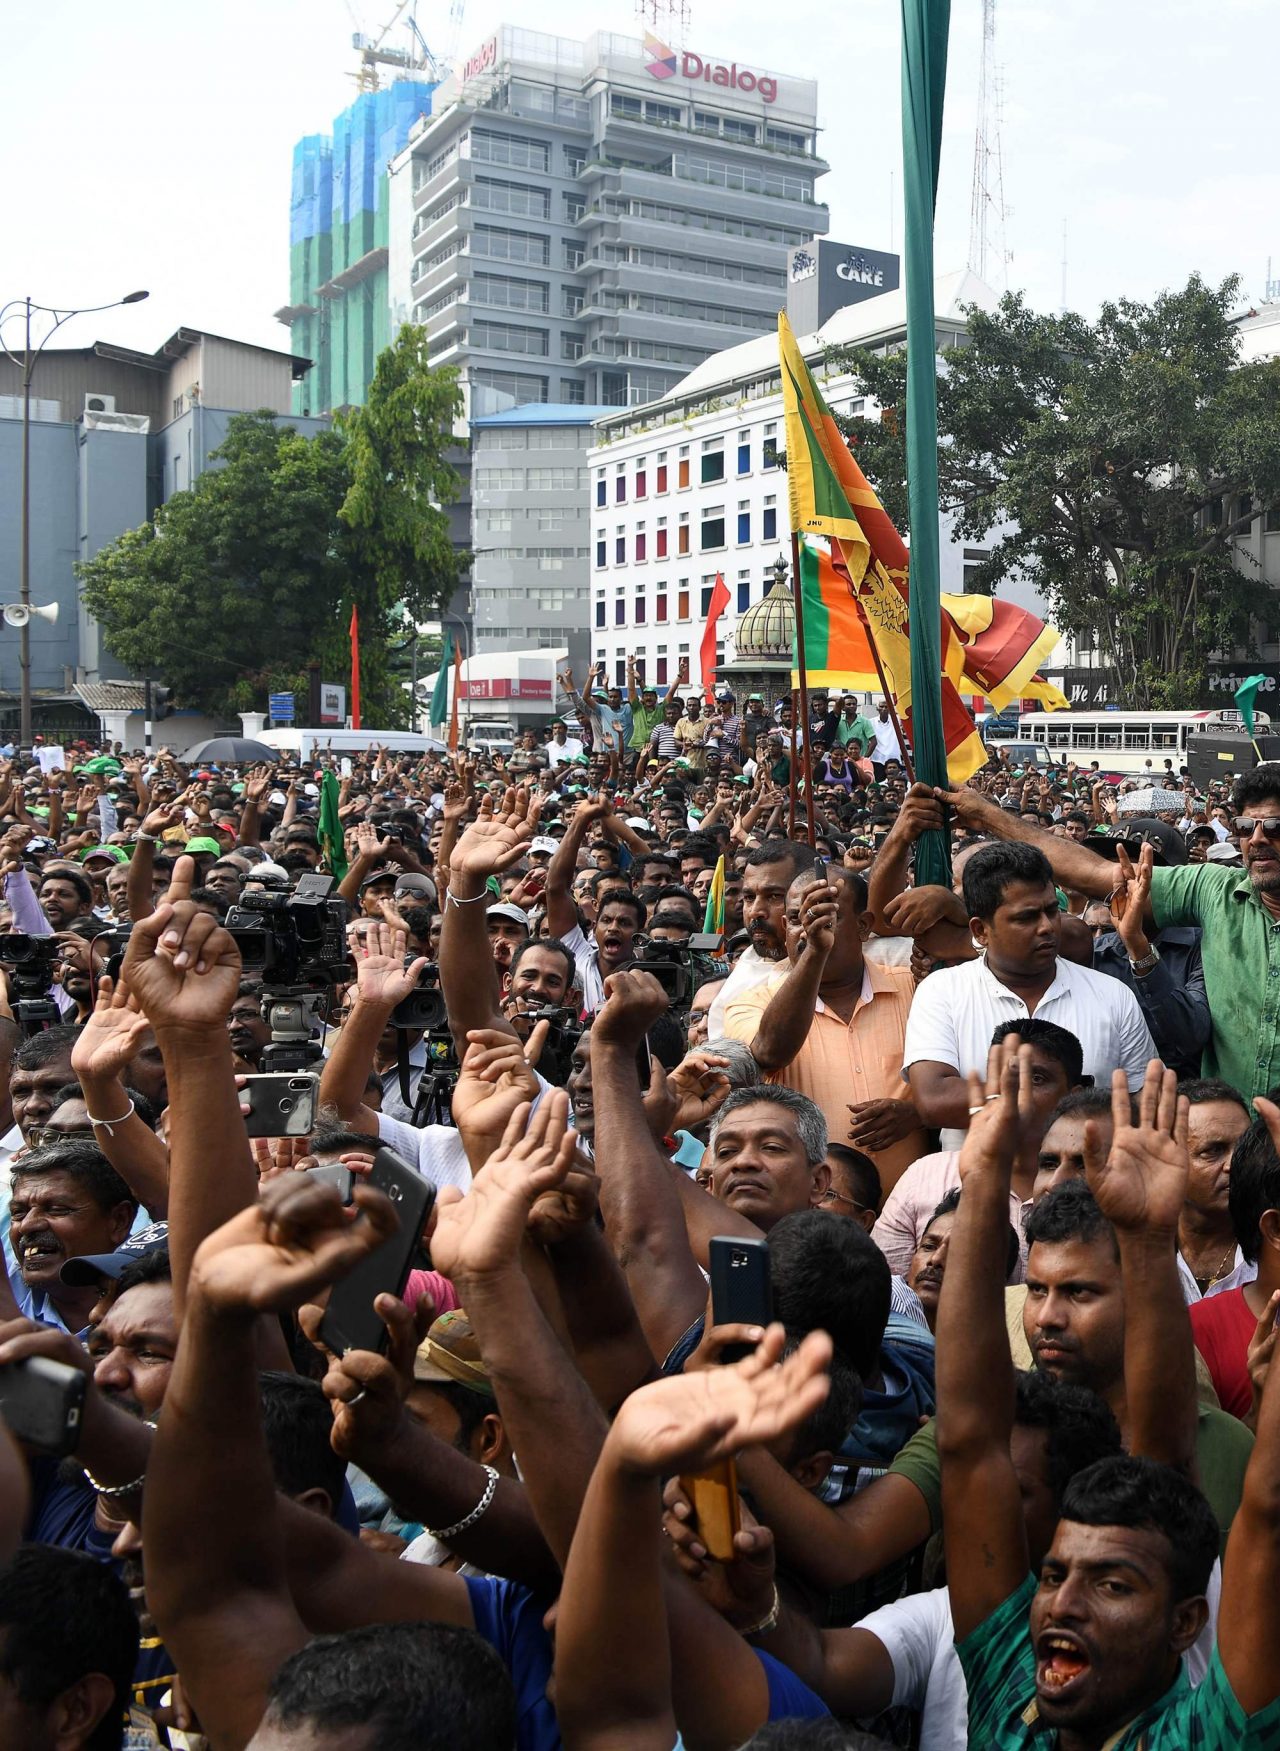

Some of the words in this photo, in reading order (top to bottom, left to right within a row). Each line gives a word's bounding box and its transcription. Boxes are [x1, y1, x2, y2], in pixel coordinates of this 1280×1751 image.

[682, 50, 777, 103] Dialog
[836, 262, 883, 287] CARE
[1208, 672, 1276, 692] Privte
[1069, 684, 1088, 703] We
